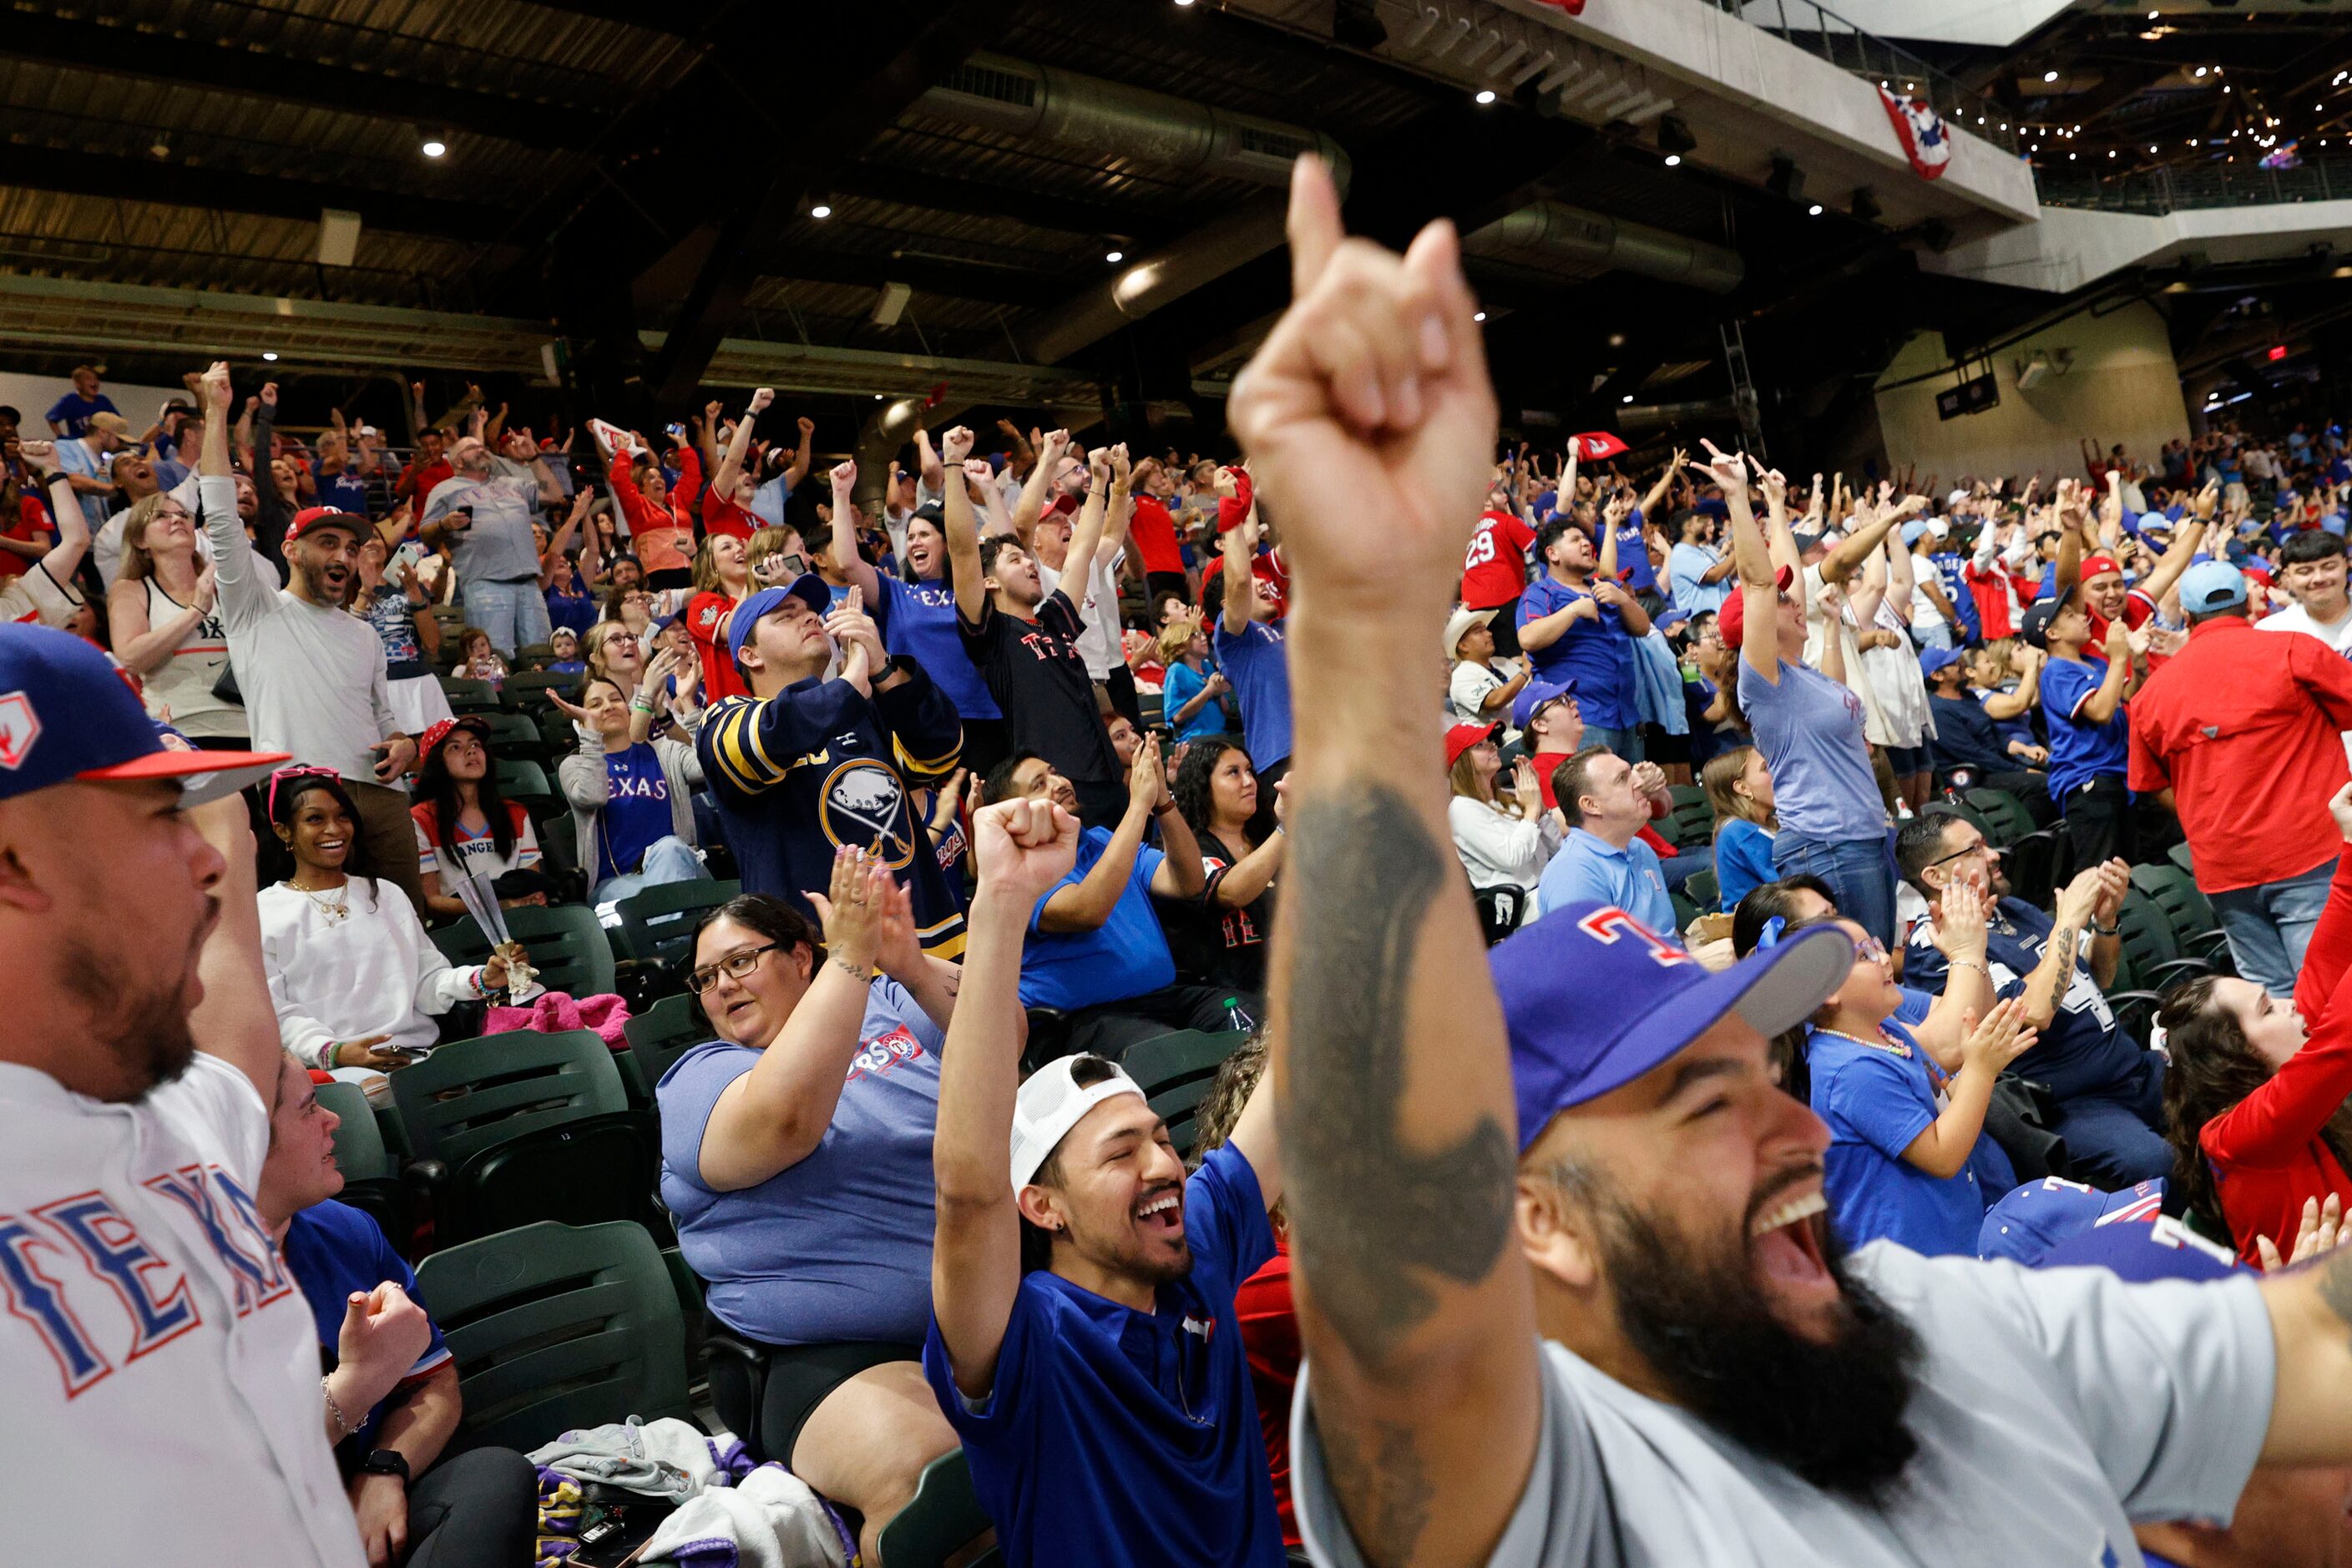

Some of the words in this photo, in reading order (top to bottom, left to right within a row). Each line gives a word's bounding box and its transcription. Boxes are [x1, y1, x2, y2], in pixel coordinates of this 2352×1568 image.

[1465, 530, 1495, 570] 29
[1644, 869, 1662, 891] T
[1576, 905, 1693, 968] T
[2151, 1213, 2238, 1267] T
